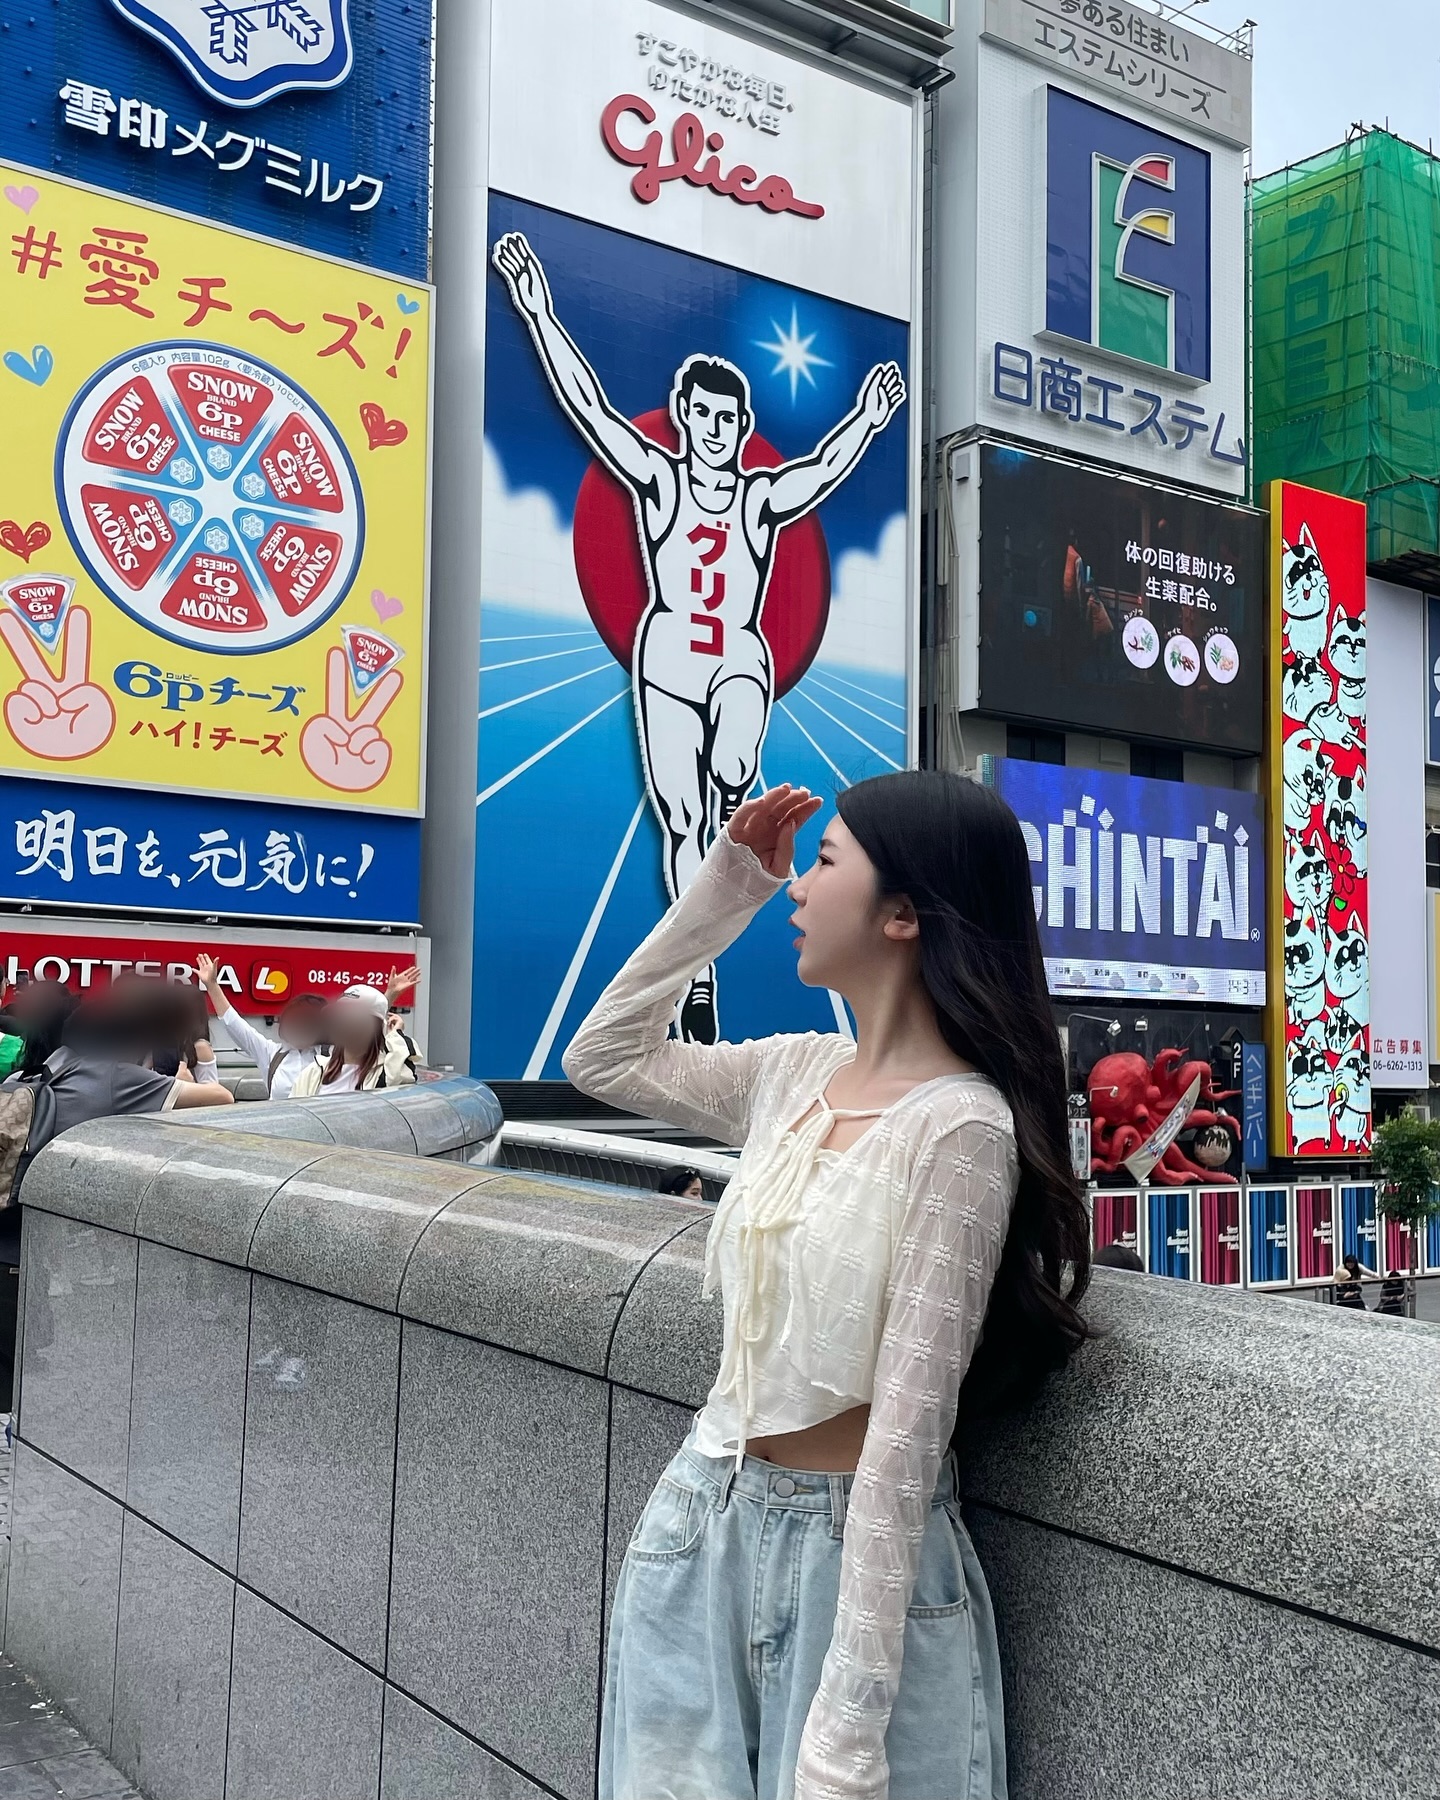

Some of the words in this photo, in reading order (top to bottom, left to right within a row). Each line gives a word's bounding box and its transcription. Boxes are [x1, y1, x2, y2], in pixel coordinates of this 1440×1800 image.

[635, 31, 795, 112] すこやかな毎日、
[1035, 19, 1211, 119] エステムシリーズ
[648, 64, 781, 136] ゆたかな人生
[59, 79, 383, 211] 雪印メグミルク
[602, 94, 824, 219] Glico
[131, 355, 166, 373] 6個入り
[187, 371, 257, 404] SNOW
[206, 395, 237, 407] BRAND
[994, 342, 1247, 465] 日商エステム
[94, 386, 145, 452] SNOW
[120, 416, 142, 444] BRAND
[197, 401, 243, 430] 6P
[198, 424, 241, 442] CHEESE
[126, 422, 161, 460] 6P
[146, 435, 176, 472] CHEESE
[262, 457, 288, 499] CHEESE
[277, 449, 302, 495] 6P
[292, 431, 337, 497] SNOW
[294, 454, 312, 484] BRAND
[88, 502, 139, 571] SNOW
[117, 515, 137, 548] BRAND
[129, 503, 157, 551] 6P
[144, 499, 172, 542] CHEESE
[260, 525, 286, 561] CHEESE
[273, 536, 305, 572] 6P
[195, 556, 238, 574] CHEESE
[289, 543, 332, 606] SNOW
[290, 552, 311, 578] BRAND
[1125, 540, 1236, 585] 体の回復助ける
[18, 586, 56, 600] SNOW
[192, 569, 239, 597] 6P
[198, 592, 230, 604] BRAND
[686, 521, 731, 657] グリコ
[1145, 576, 1217, 611] 生薬配合。
[28, 601, 54, 614] 6P
[177, 597, 249, 626] SNOW
[356, 636, 388, 656] SNOW
[357, 650, 378, 666] 6P
[166, 672, 200, 682] ロッピー
[129, 720, 288, 757] ハイ!チーズ
[15, 809, 375, 898] 明日を、元気に!
[7, 955, 243, 993] LOTTERA
[1233, 1042, 1242, 1079] 2F
[1373, 1039, 1422, 1055] 広告募集
[1373, 1060, 1423, 1071] 06-6262-1313
